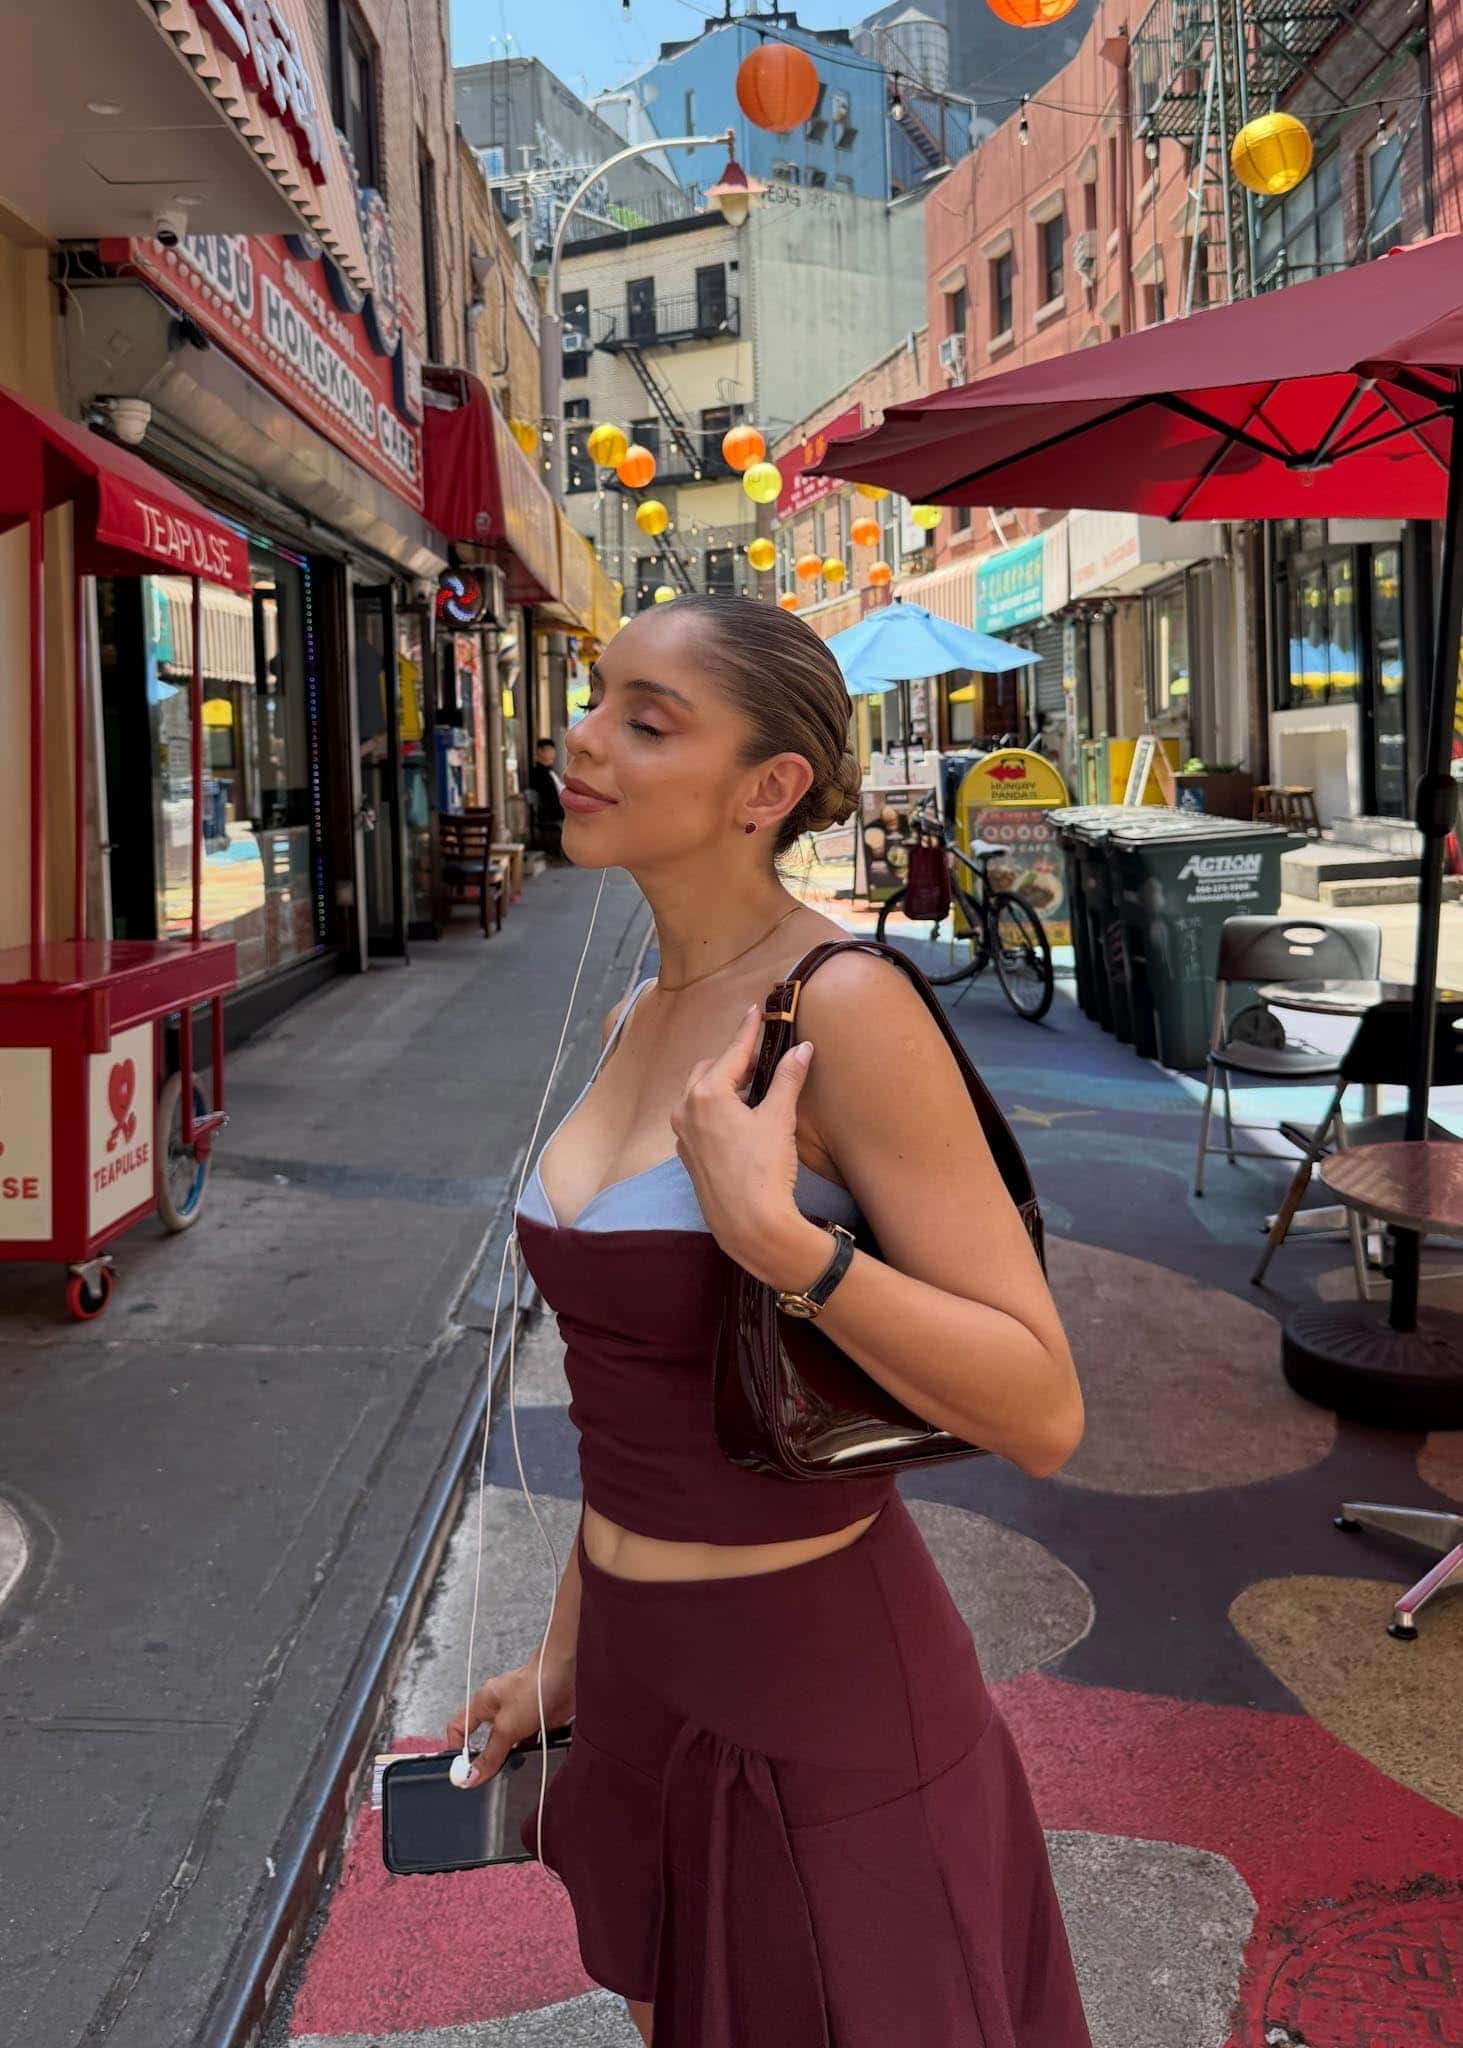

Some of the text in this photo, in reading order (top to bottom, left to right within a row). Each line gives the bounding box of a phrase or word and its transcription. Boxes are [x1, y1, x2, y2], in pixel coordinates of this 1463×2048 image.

[260, 274, 376, 440] HONGKONG
[134, 499, 233, 580] TEAPULSE
[991, 782, 1036, 790] HUNGRY
[1177, 853, 1262, 880] ACTION
[93, 1143, 149, 1193] TEAPULSE
